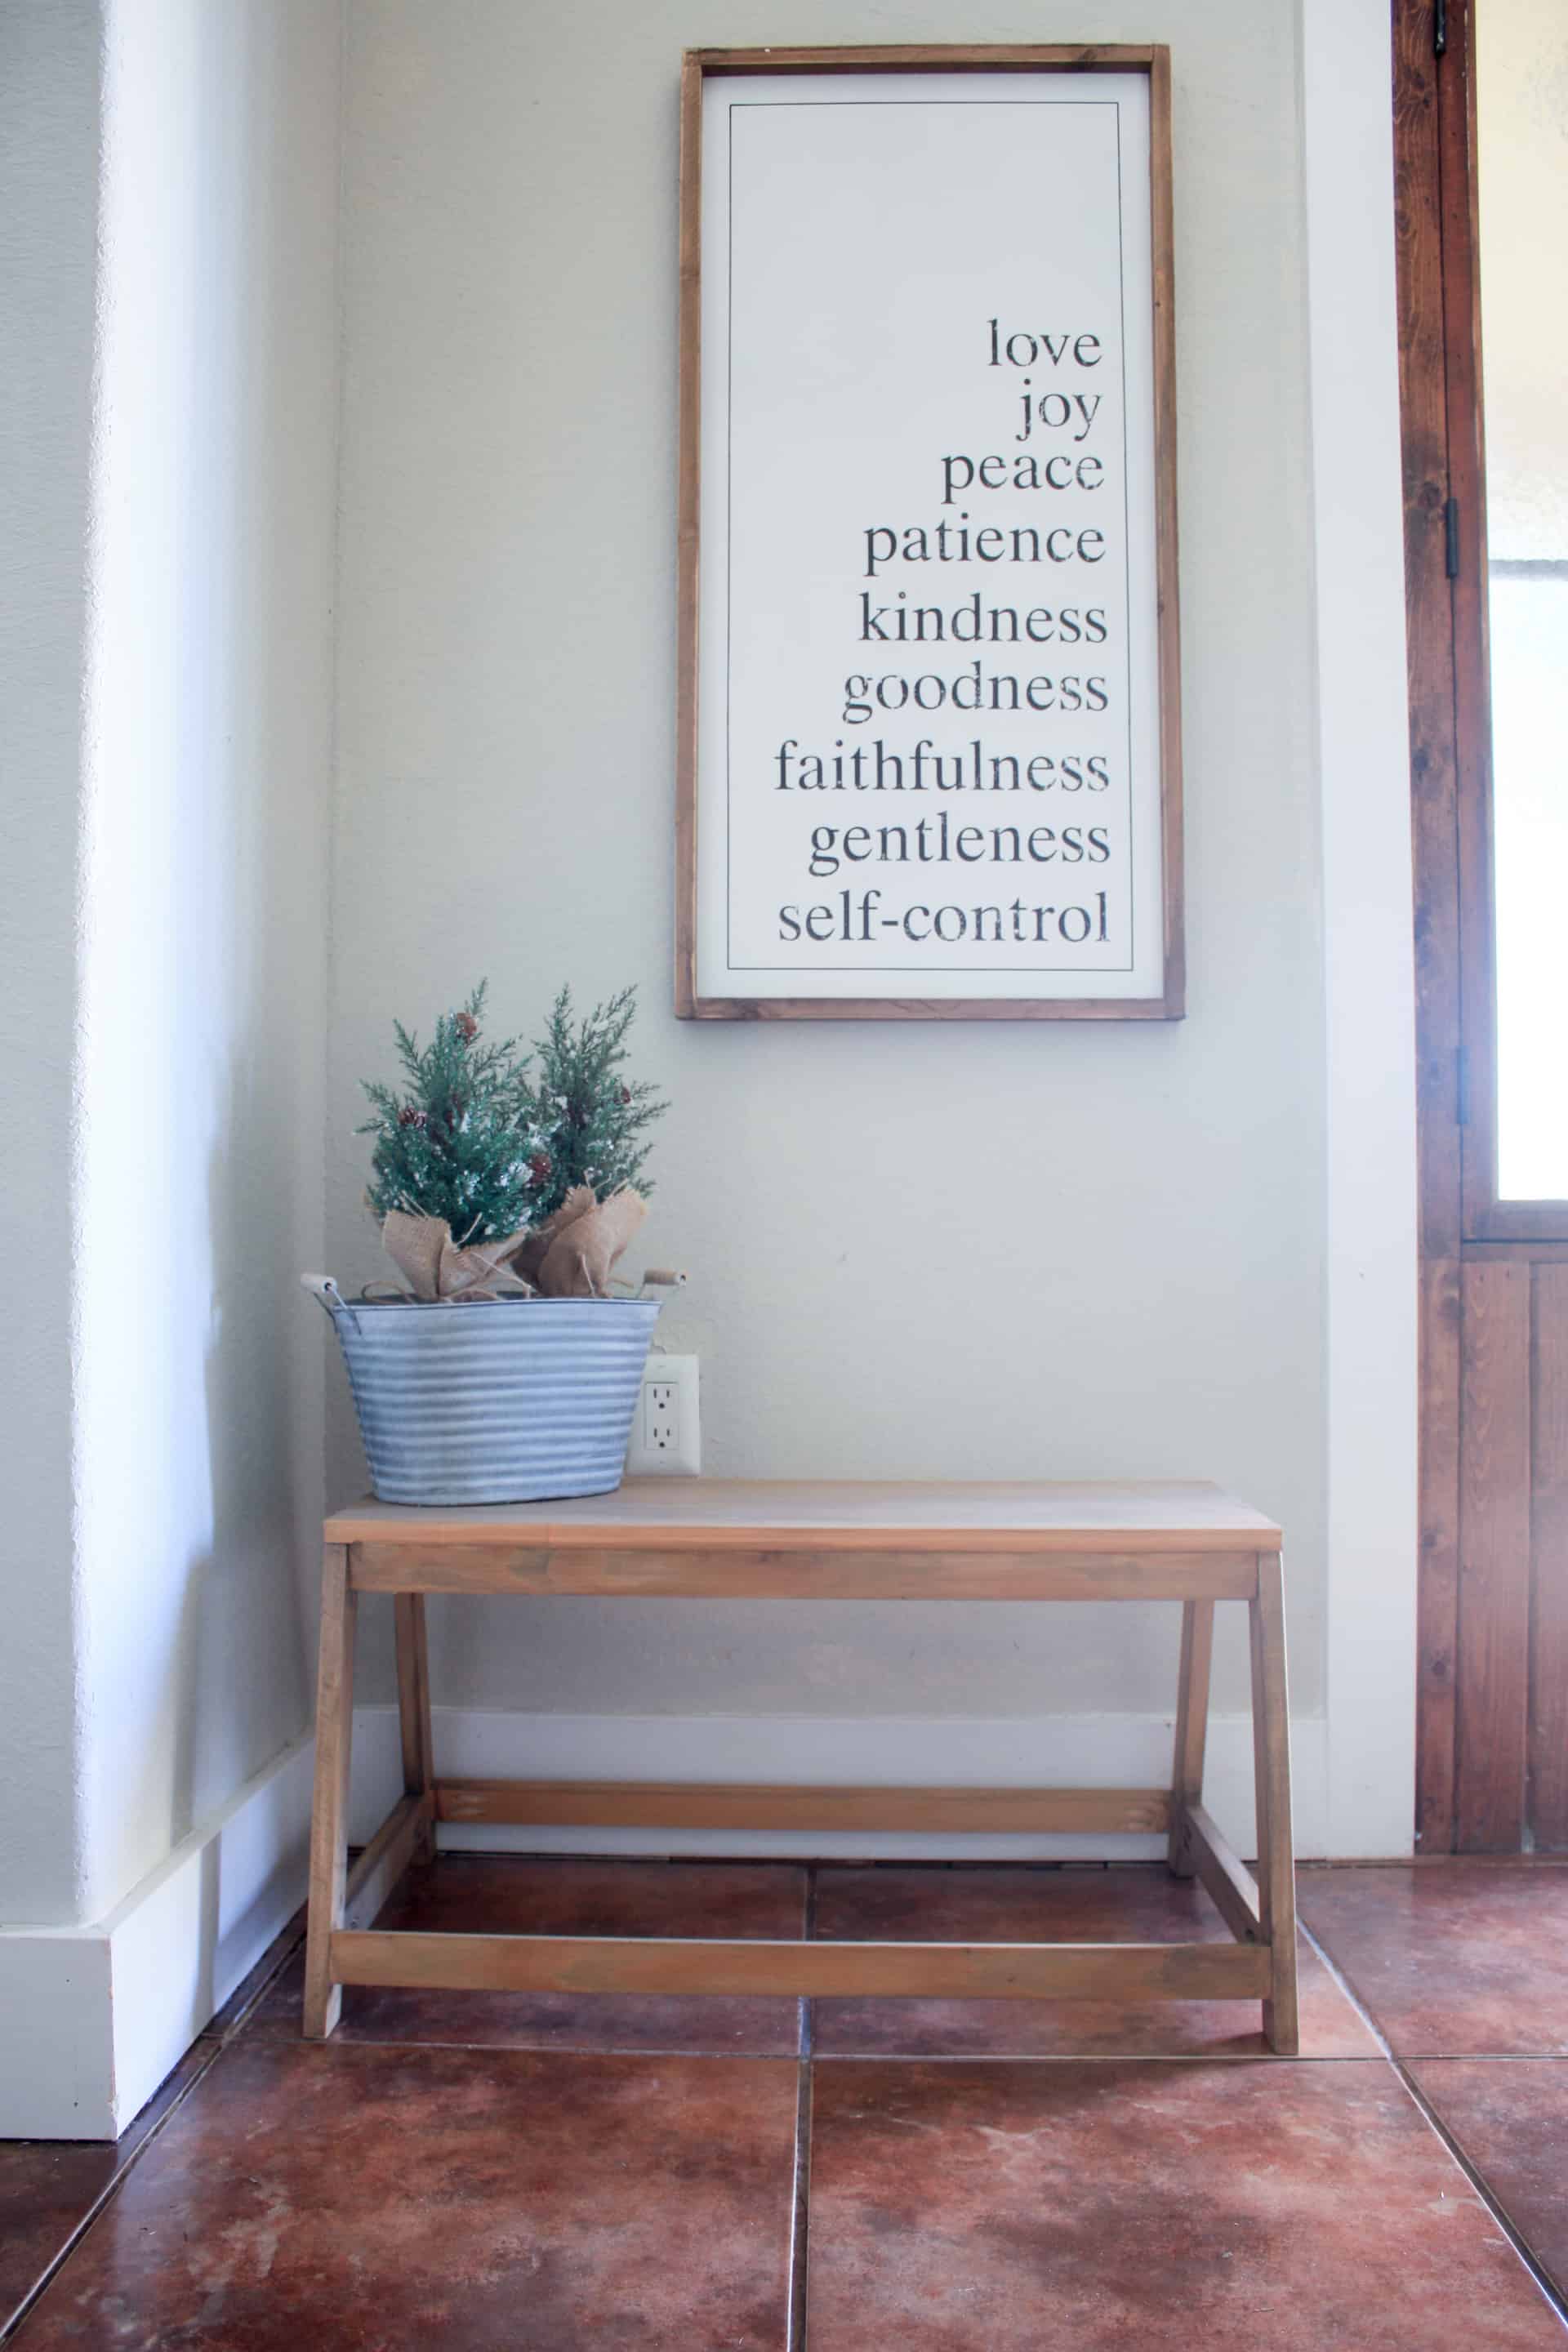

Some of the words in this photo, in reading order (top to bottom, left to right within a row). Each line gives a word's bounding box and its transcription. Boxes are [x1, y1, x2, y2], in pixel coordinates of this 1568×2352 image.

[988, 318, 1102, 368] love
[1015, 378, 1102, 442] joy
[940, 455, 1104, 505] peace
[863, 512, 1105, 577] patience
[858, 591, 1108, 643] kindness
[841, 660, 1109, 724] goodness
[774, 739, 1110, 792] faithfulness
[808, 811, 1111, 877] gentleness
[778, 889, 1110, 942] self-control
